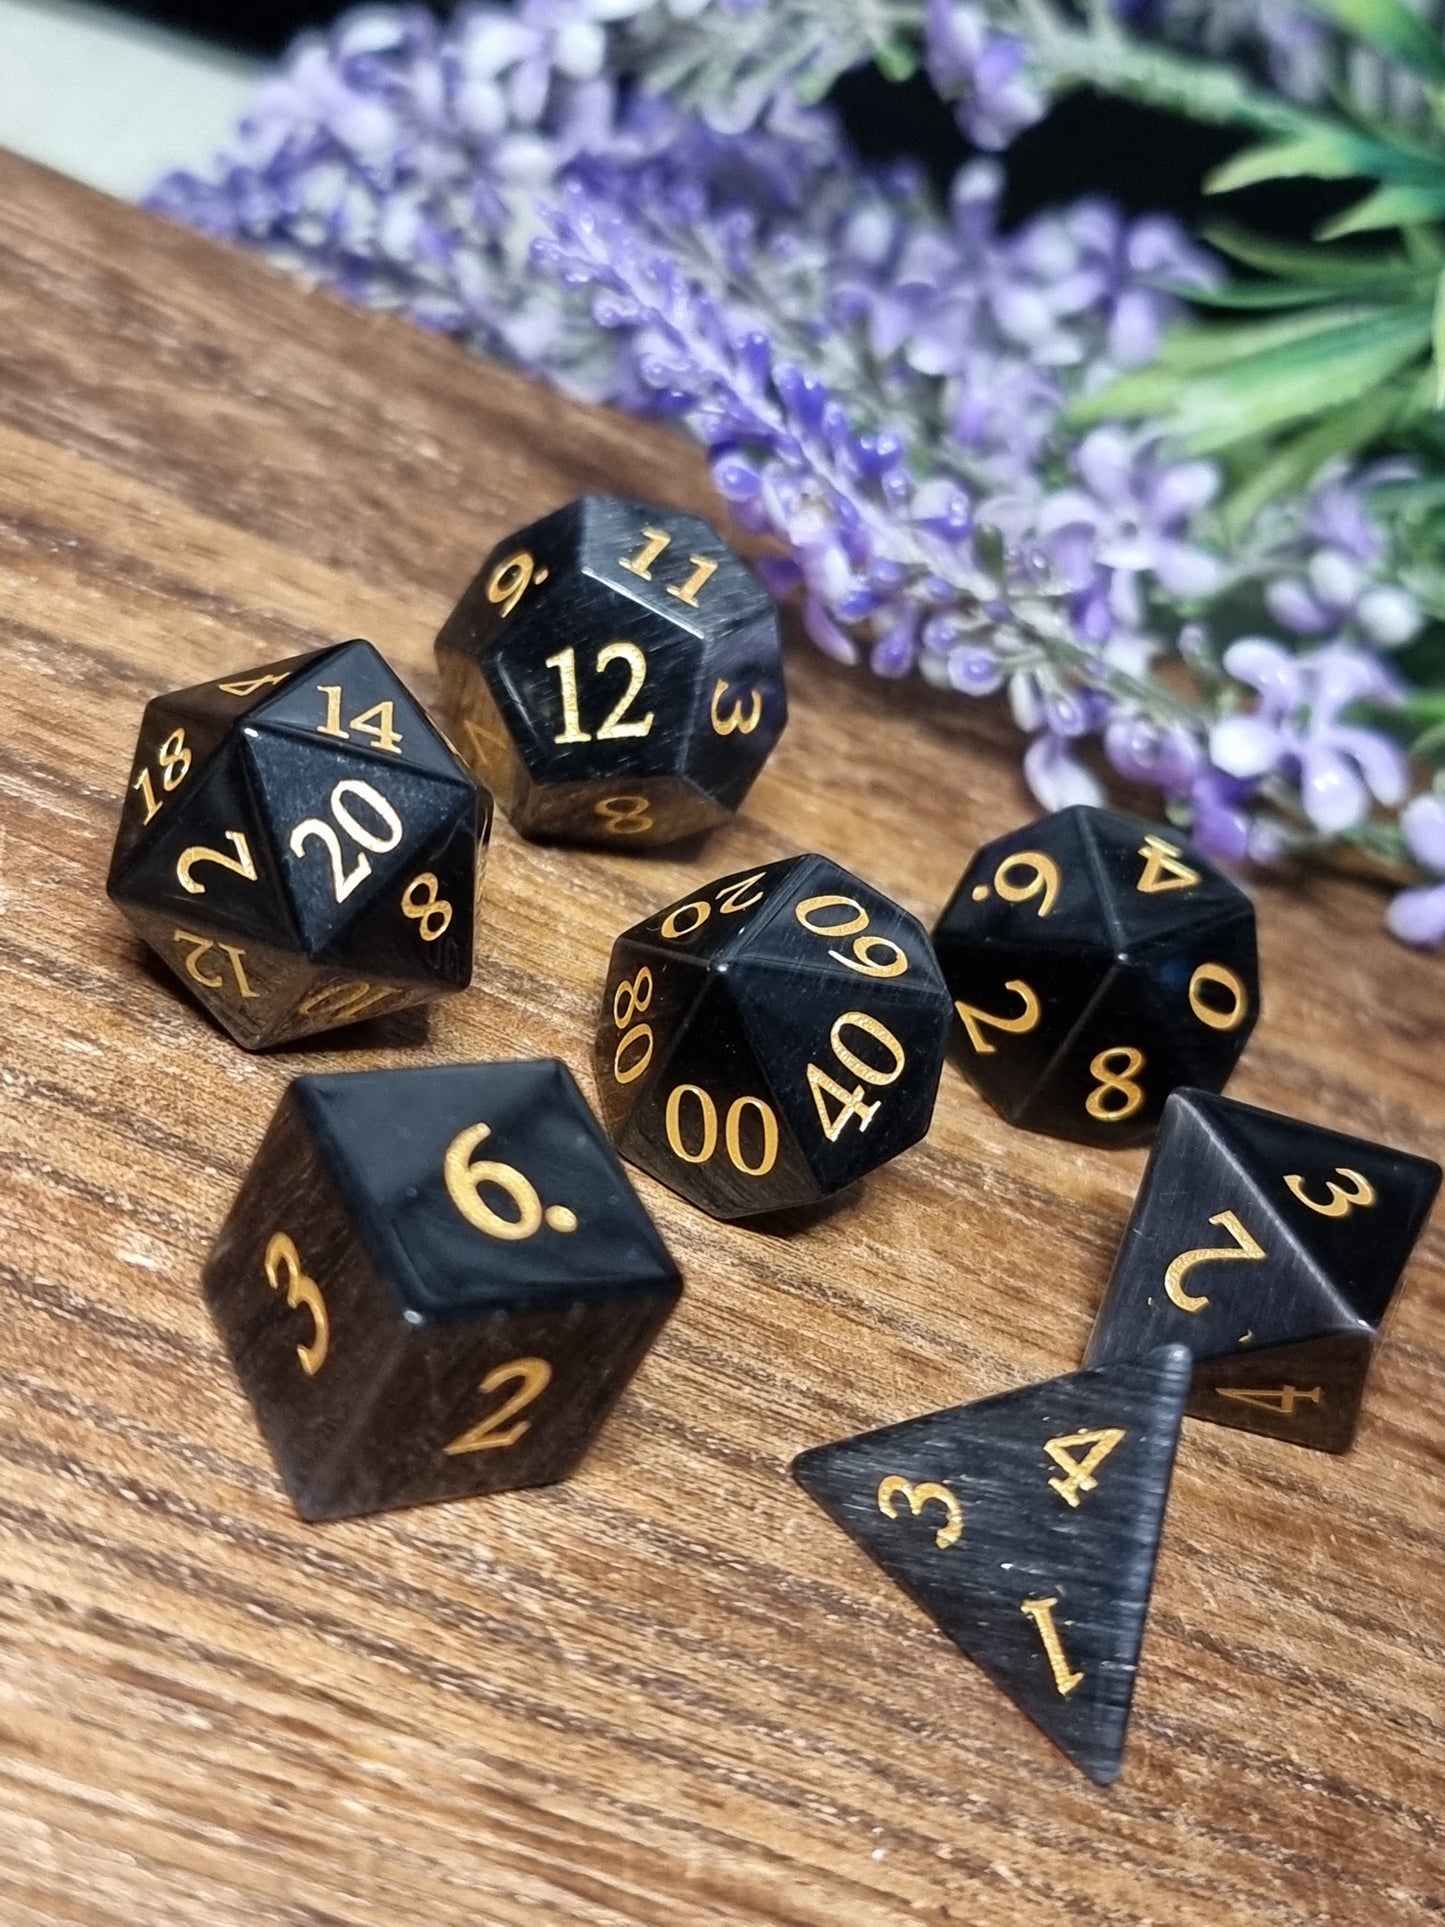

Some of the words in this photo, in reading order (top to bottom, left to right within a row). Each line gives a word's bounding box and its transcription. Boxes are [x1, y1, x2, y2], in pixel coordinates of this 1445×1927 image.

[618, 526, 718, 608] 11
[219, 672, 292, 696] 4
[316, 685, 403, 753] 14
[545, 641, 654, 744] 12
[711, 678, 762, 736] 3
[132, 727, 192, 826] 18
[289, 779, 403, 903] 20
[595, 796, 653, 834] 8
[176, 830, 257, 894] 2
[1137, 835, 1200, 892] 4
[401, 872, 452, 942] 8
[661, 872, 767, 939] 20
[173, 929, 260, 998] 12
[1188, 962, 1245, 1031] 0
[613, 966, 653, 1084] 80
[954, 980, 1040, 1052] 2
[806, 1011, 906, 1142] 40
[1085, 1046, 1143, 1121] 8
[665, 1084, 779, 1177] 00
[1283, 1167, 1374, 1217] 3
[1164, 1210, 1267, 1313] 2
[264, 1231, 330, 1376] 3
[443, 1357, 553, 1456] 2
[1215, 1385, 1321, 1414] 4
[1043, 1427, 1127, 1508] 4
[877, 1475, 965, 1550] 3
[1021, 1597, 1085, 1697] 1
